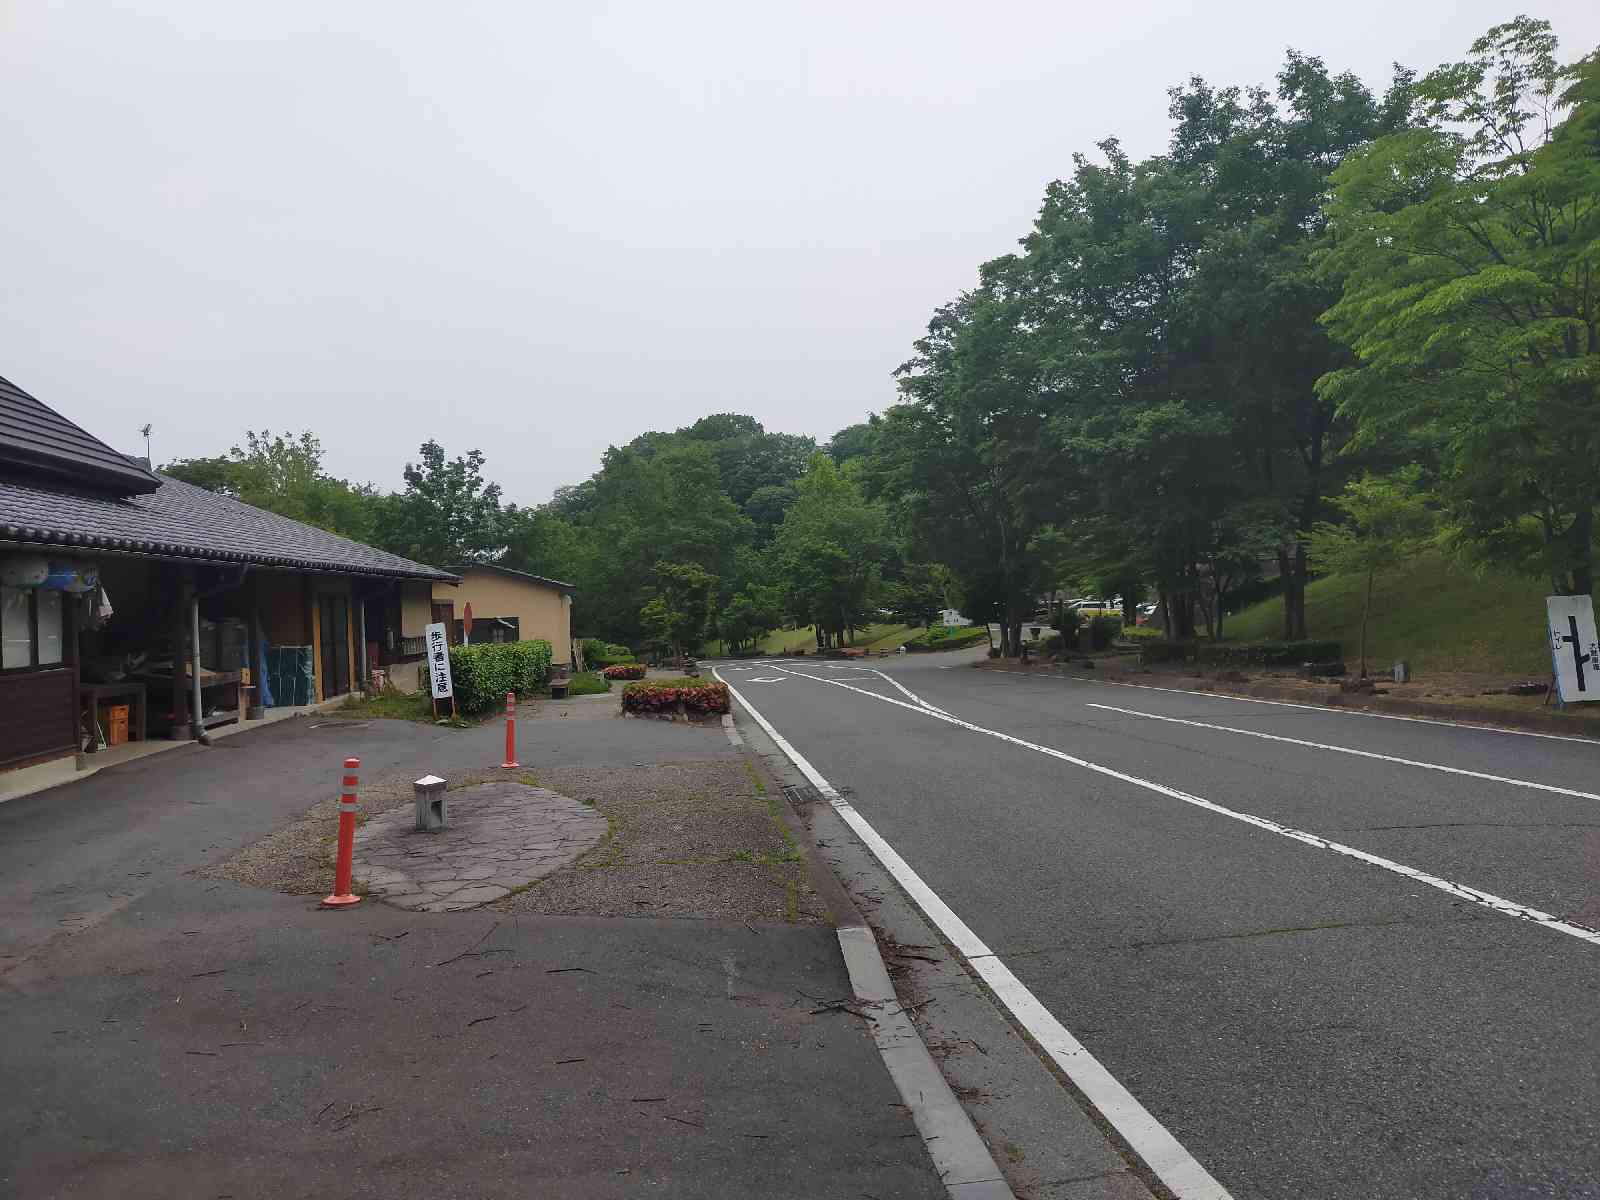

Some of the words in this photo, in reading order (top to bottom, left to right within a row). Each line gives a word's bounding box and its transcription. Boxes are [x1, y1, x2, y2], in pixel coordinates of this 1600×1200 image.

[431, 631, 448, 694] 歩行者に注意
